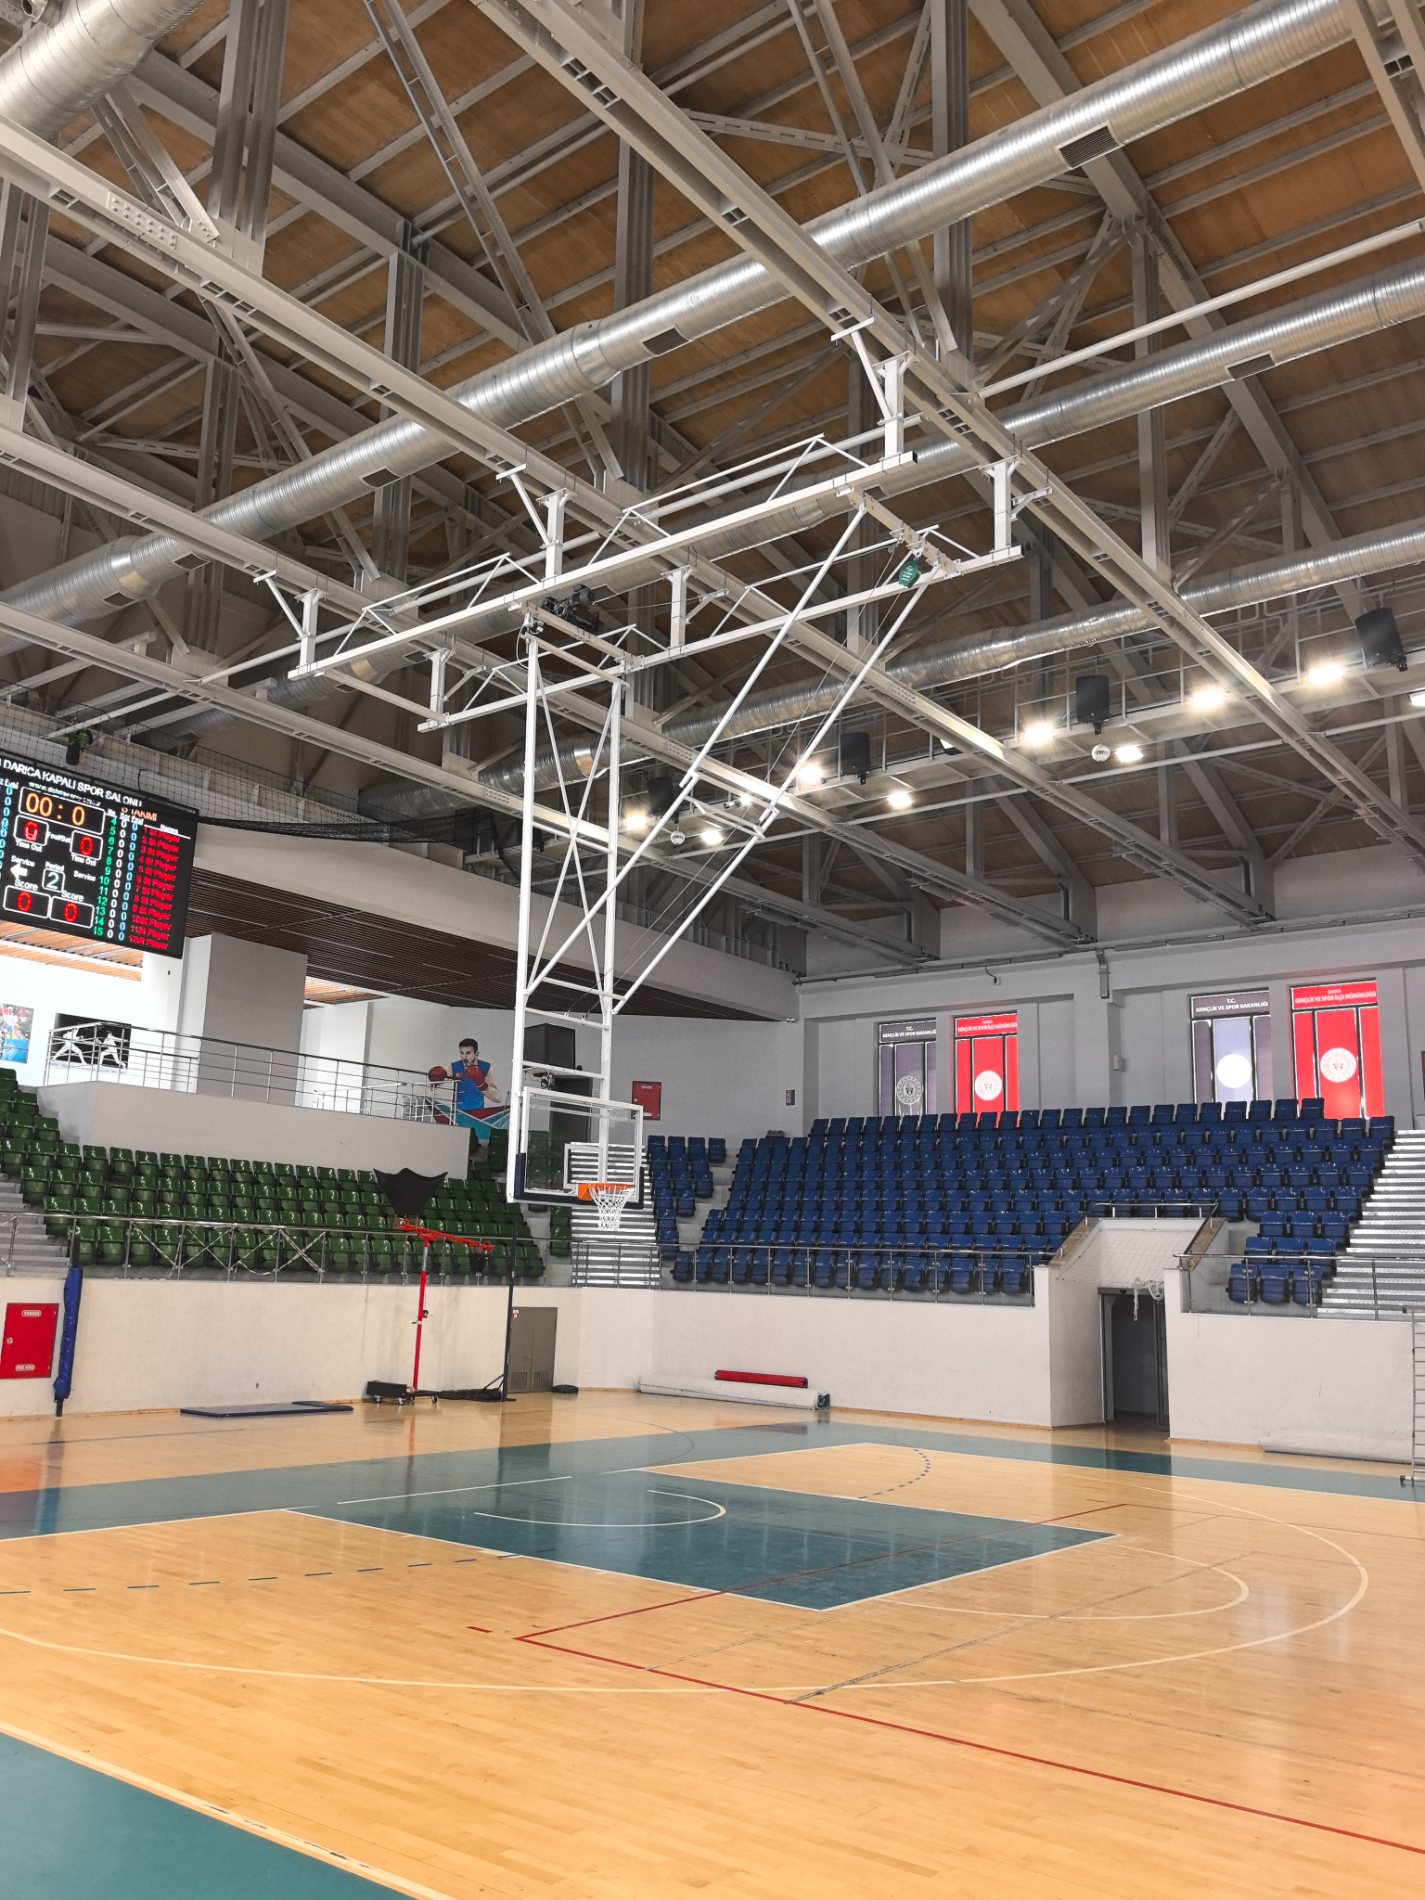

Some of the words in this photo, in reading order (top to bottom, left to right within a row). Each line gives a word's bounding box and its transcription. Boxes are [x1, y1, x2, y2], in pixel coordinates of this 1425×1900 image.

[4, 759, 41, 779] DARICA
[42, 771, 76, 790] KAPALI
[77, 782, 104, 798] SPOR
[121, 820, 127, 828] 0
[120, 829, 126, 838] 0
[131, 832, 136, 841] 0
[80, 836, 93, 856] 0
[118, 839, 125, 848] 0
[130, 842, 136, 851] 0
[11, 854, 35, 867] Service
[118, 849, 124, 858] 0
[129, 852, 134, 861] 0
[116, 859, 122, 868] 0
[128, 862, 134, 871] 0
[46, 872, 60, 889] 2
[74, 870, 96, 882] Service
[116, 869, 122, 878] 0
[127, 872, 132, 881] 0
[15, 878, 39, 891] Score
[99, 876, 109, 885] 10
[114, 879, 120, 888] 0
[125, 882, 131, 891] 0
[61, 889, 84, 902] Score
[99, 886, 108, 895] 11
[112, 889, 118, 898] 0
[124, 892, 129, 901] 0
[17, 890, 32, 912] 0
[97, 896, 107, 906] 12
[111, 899, 117, 908] 0
[122, 902, 128, 911] 0
[63, 901, 78, 923] 0
[96, 906, 106, 915] 13
[110, 909, 116, 918] 0
[121, 912, 127, 921] 0
[94, 916, 104, 926] 14
[108, 919, 114, 928] 0
[120, 921, 125, 930] 0
[94, 927, 103, 936] 15
[107, 929, 113, 938] 0
[118, 932, 124, 941] 0
